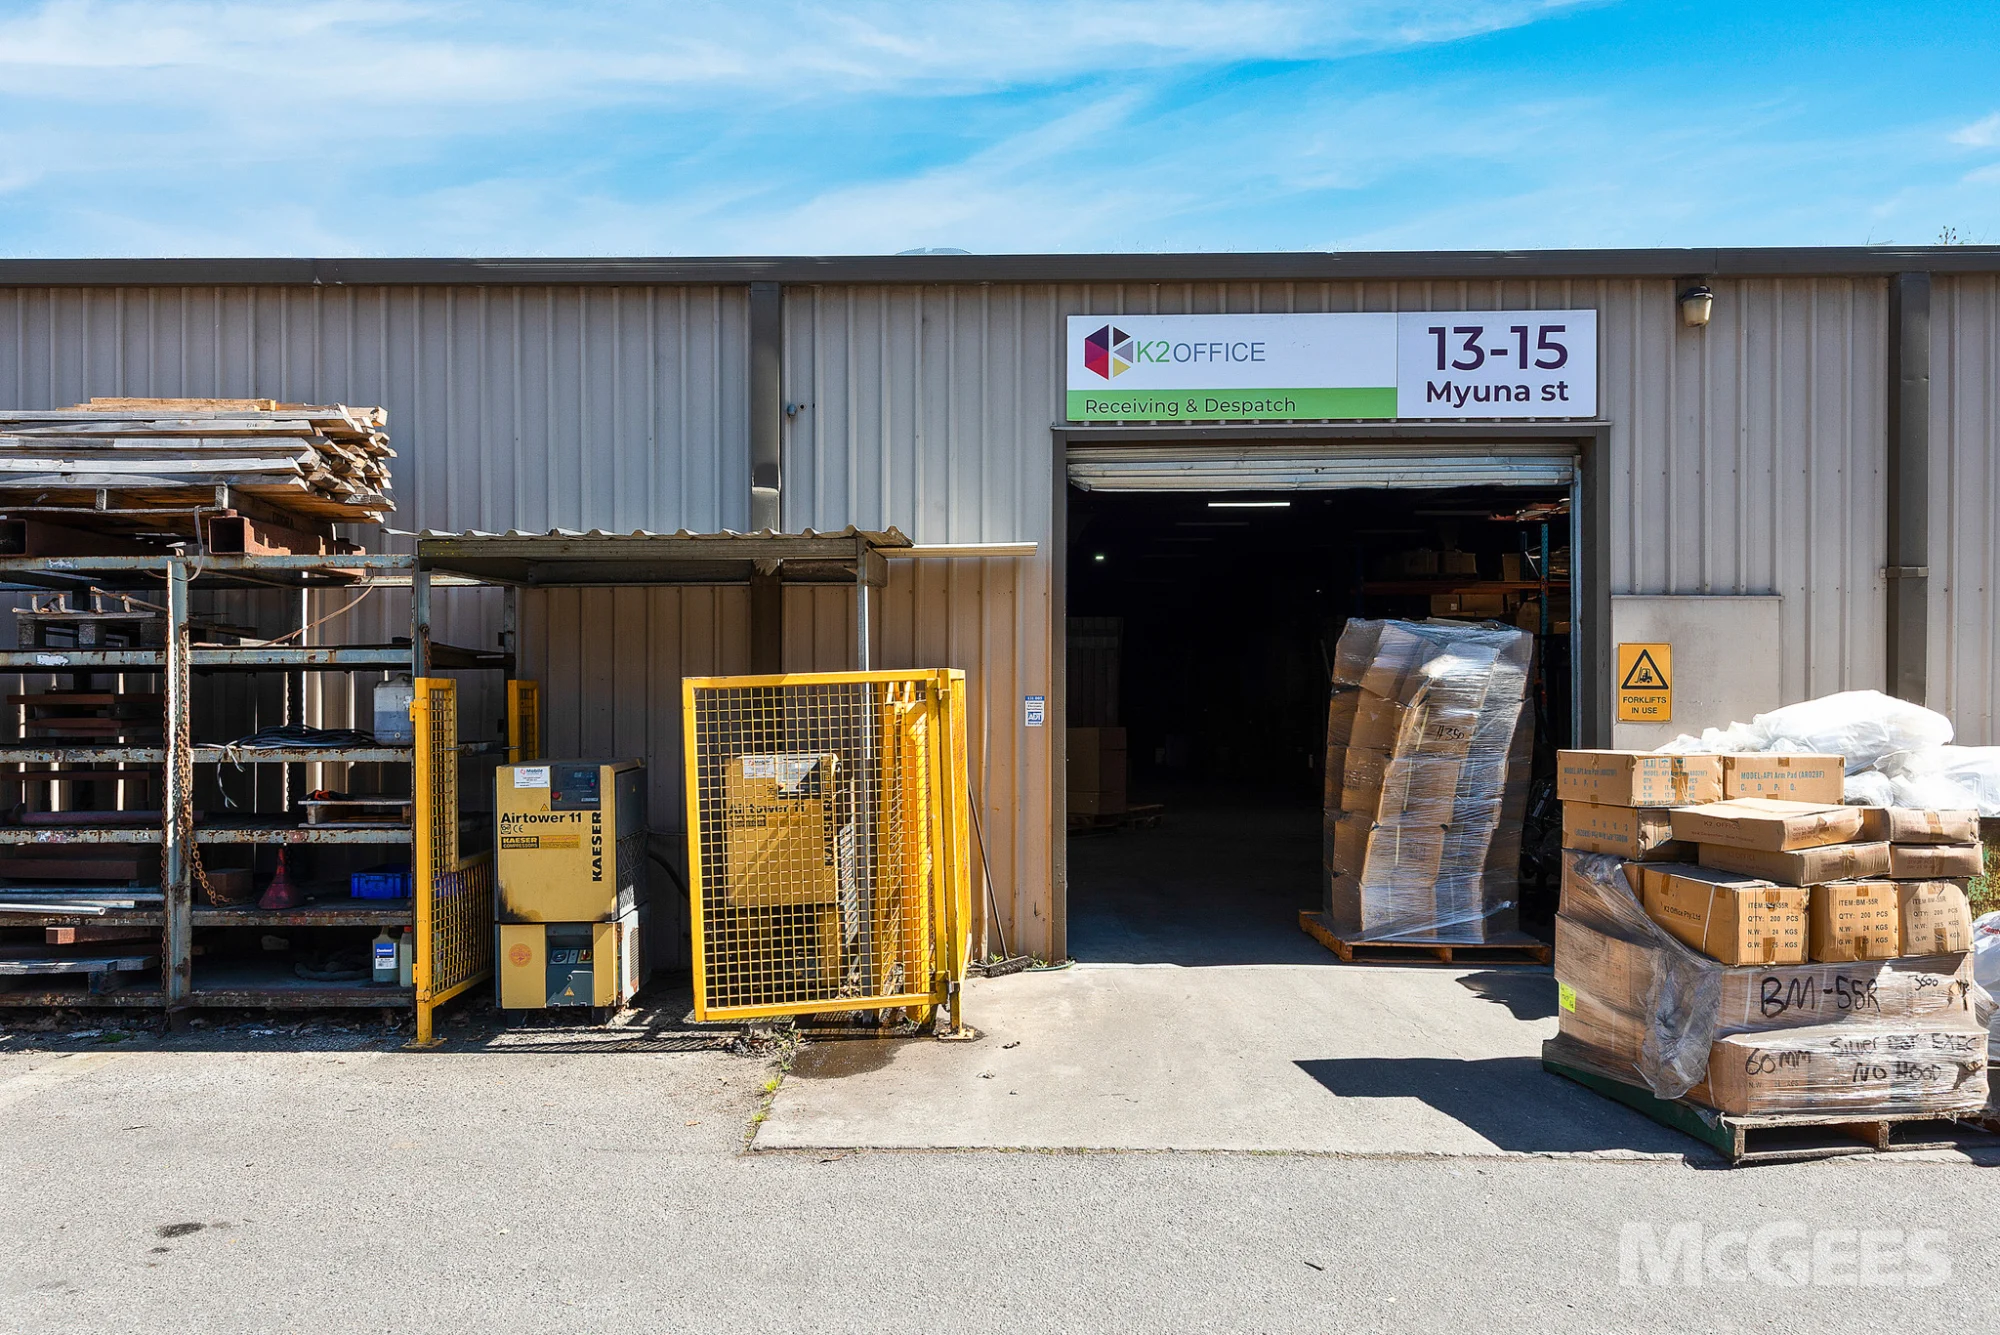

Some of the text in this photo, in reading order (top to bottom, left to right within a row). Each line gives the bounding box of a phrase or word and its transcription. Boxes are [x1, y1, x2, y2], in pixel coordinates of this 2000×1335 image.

[1428, 324, 1569, 371] 13-15
[1426, 380, 1569, 409] Myuna st
[1085, 396, 1297, 418] Receiving & Despatch
[1622, 696, 1667, 704] FORKLIFTS
[501, 812, 582, 823] Airtower 11
[592, 811, 602, 882] KAESER
[1838, 898, 1879, 907] ITEM:BM-55R
[1760, 975, 1880, 1018] BM-55R
[1853, 1062, 1887, 1082] NO
